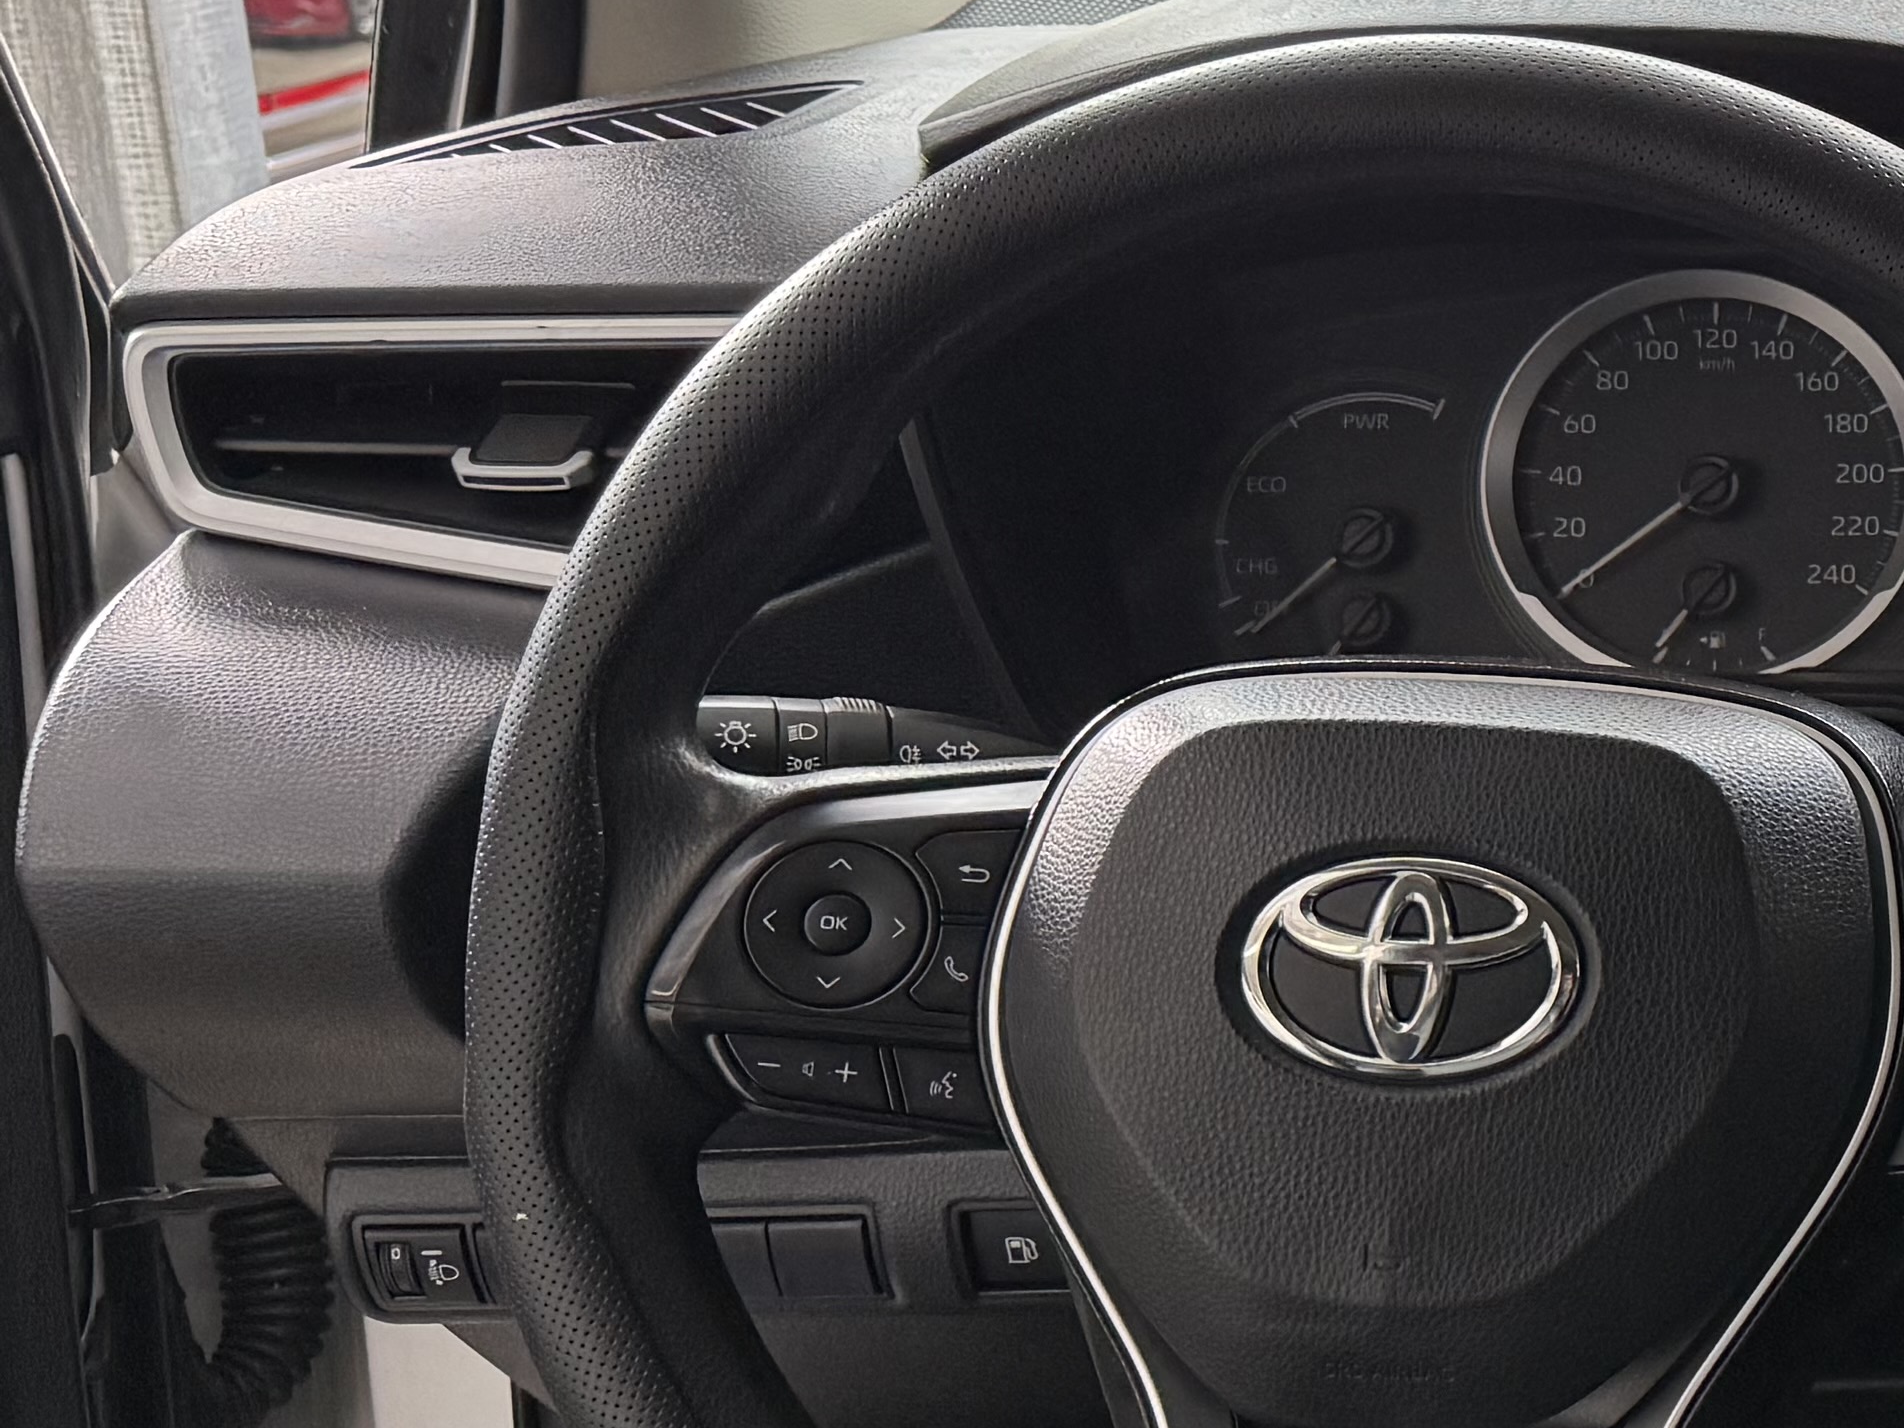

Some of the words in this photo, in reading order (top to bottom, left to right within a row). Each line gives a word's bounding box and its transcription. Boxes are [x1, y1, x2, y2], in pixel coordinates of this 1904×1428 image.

[1693, 329, 1738, 349] 120
[1634, 340, 1679, 361] 100
[1750, 340, 1795, 361] 140
[1698, 356, 1736, 372] km/h
[1595, 370, 1629, 392] 80
[1795, 371, 1839, 392] 160
[1343, 413, 1390, 430] PWR
[1563, 413, 1597, 434] 60
[1824, 413, 1868, 434] 180
[1548, 466, 1583, 487] 40
[1836, 463, 1885, 484] 200
[1246, 476, 1287, 493] ECO
[1553, 517, 1587, 538] 20
[1831, 516, 1879, 537] 220
[1235, 557, 1279, 575] CHG
[1807, 564, 1857, 585] 240
[819, 914, 849, 932] OK
